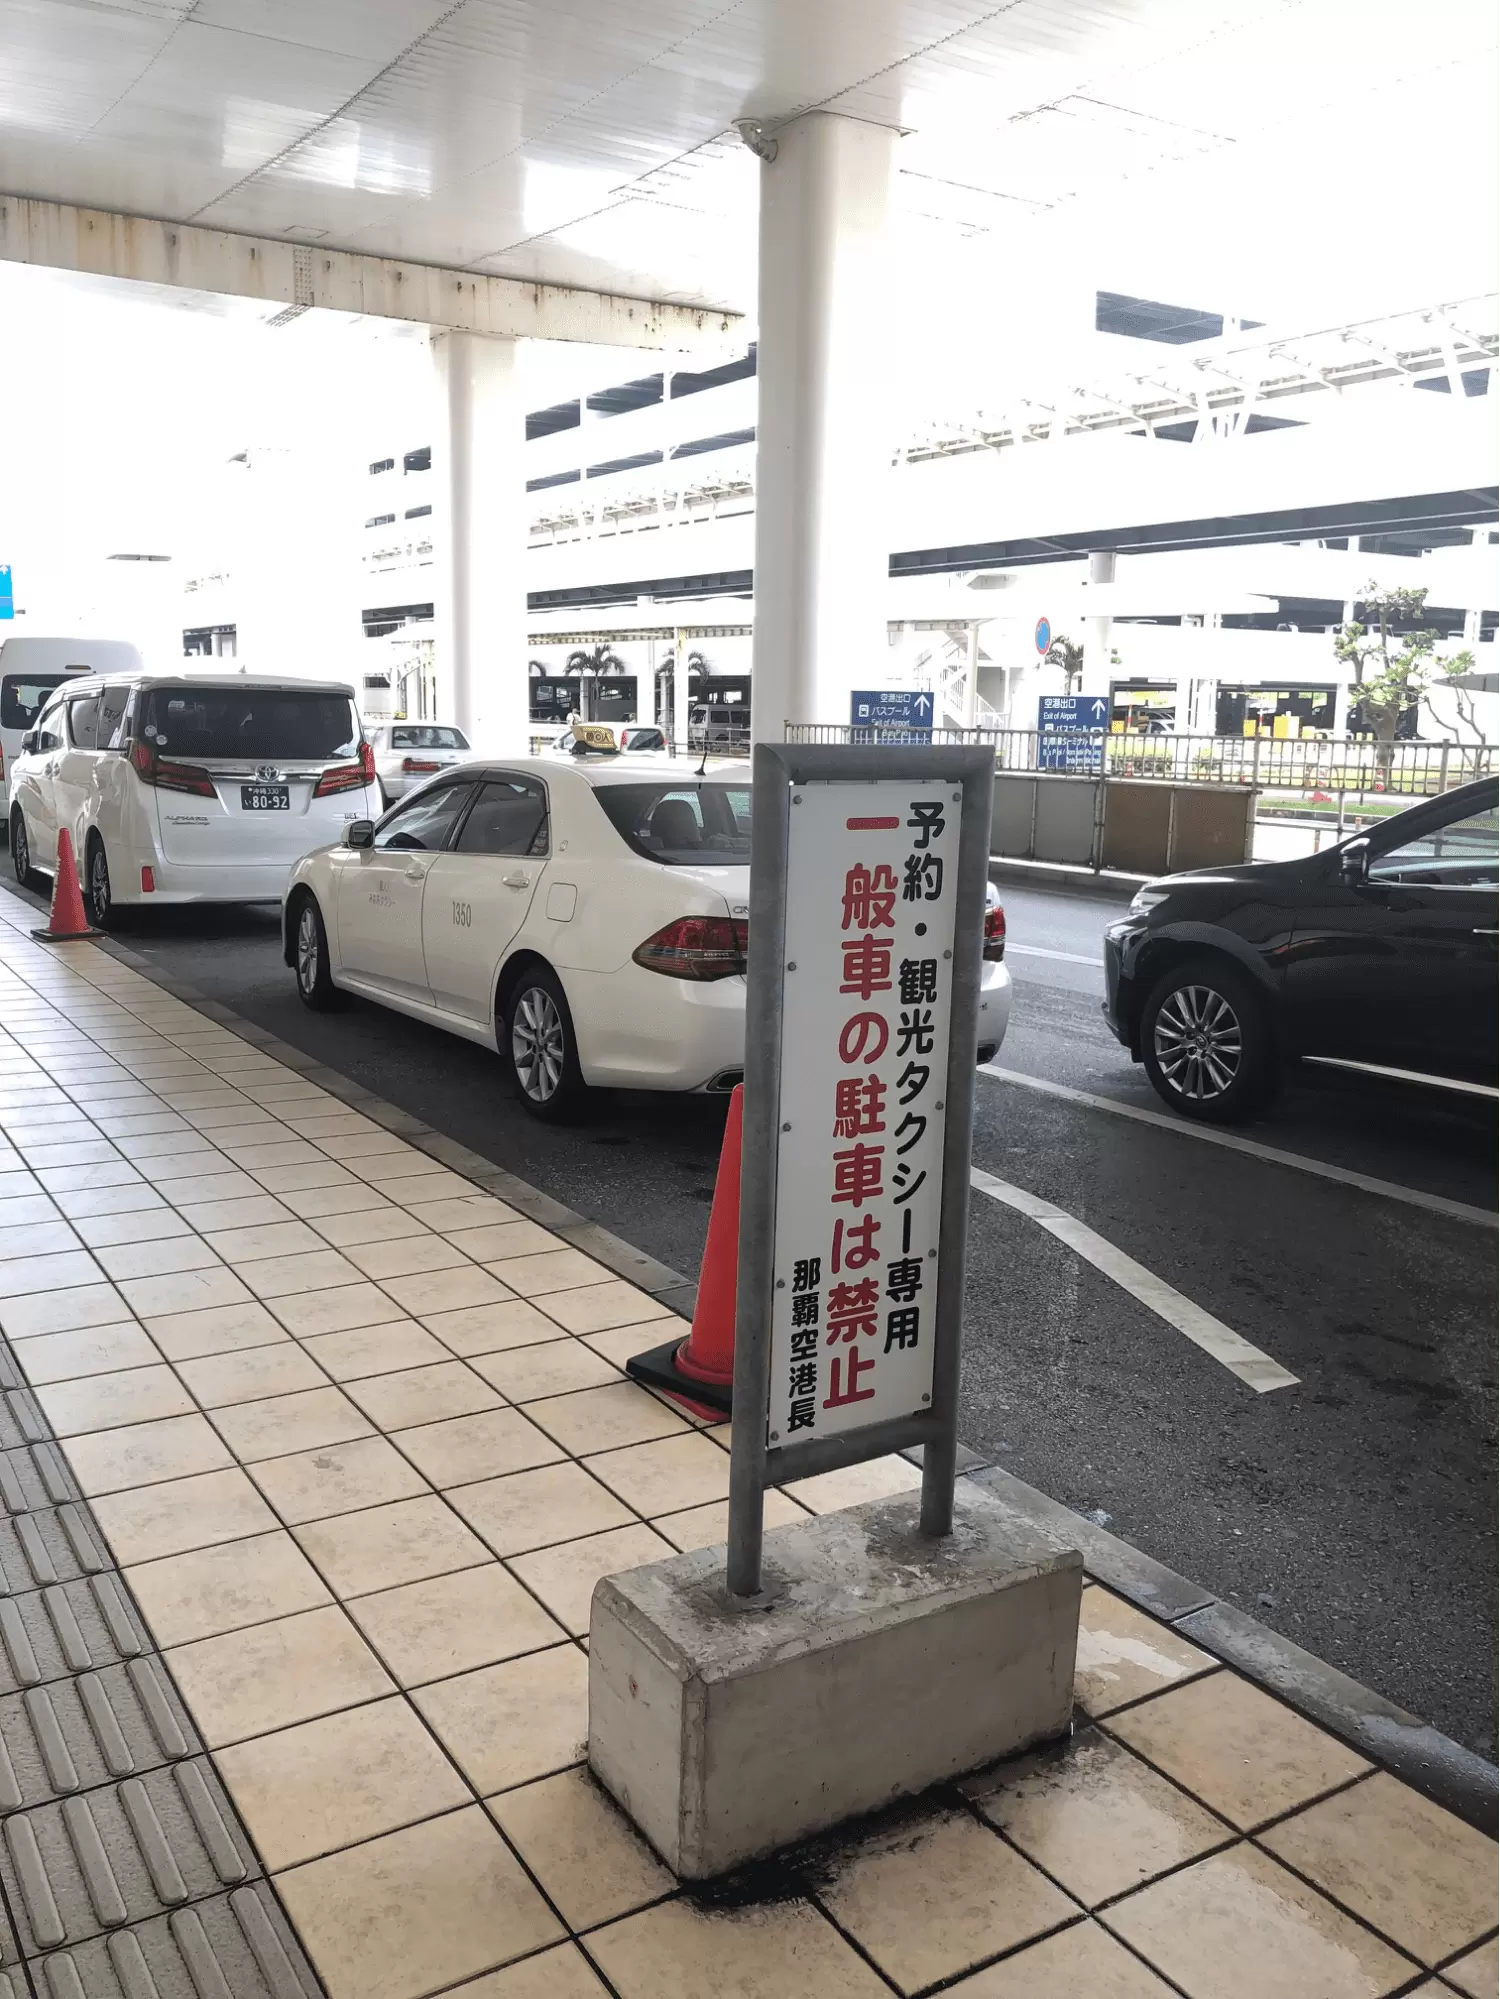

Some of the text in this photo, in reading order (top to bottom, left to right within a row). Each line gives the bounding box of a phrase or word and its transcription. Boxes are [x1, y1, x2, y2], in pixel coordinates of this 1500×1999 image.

[880, 693, 911, 702] 空港出口
[1044, 698, 1077, 709] 空港出口
[871, 706, 911, 716] バスプール
[1043, 712, 1077, 721] Exit of Airport
[252, 795, 288, 808] 80-92
[451, 899, 472, 928] 1350
[884, 802, 945, 1354] 予約・観光タクシー専用
[823, 816, 900, 1409] 一般車の駐車は禁止
[787, 1257, 822, 1433] 那覇空港長
